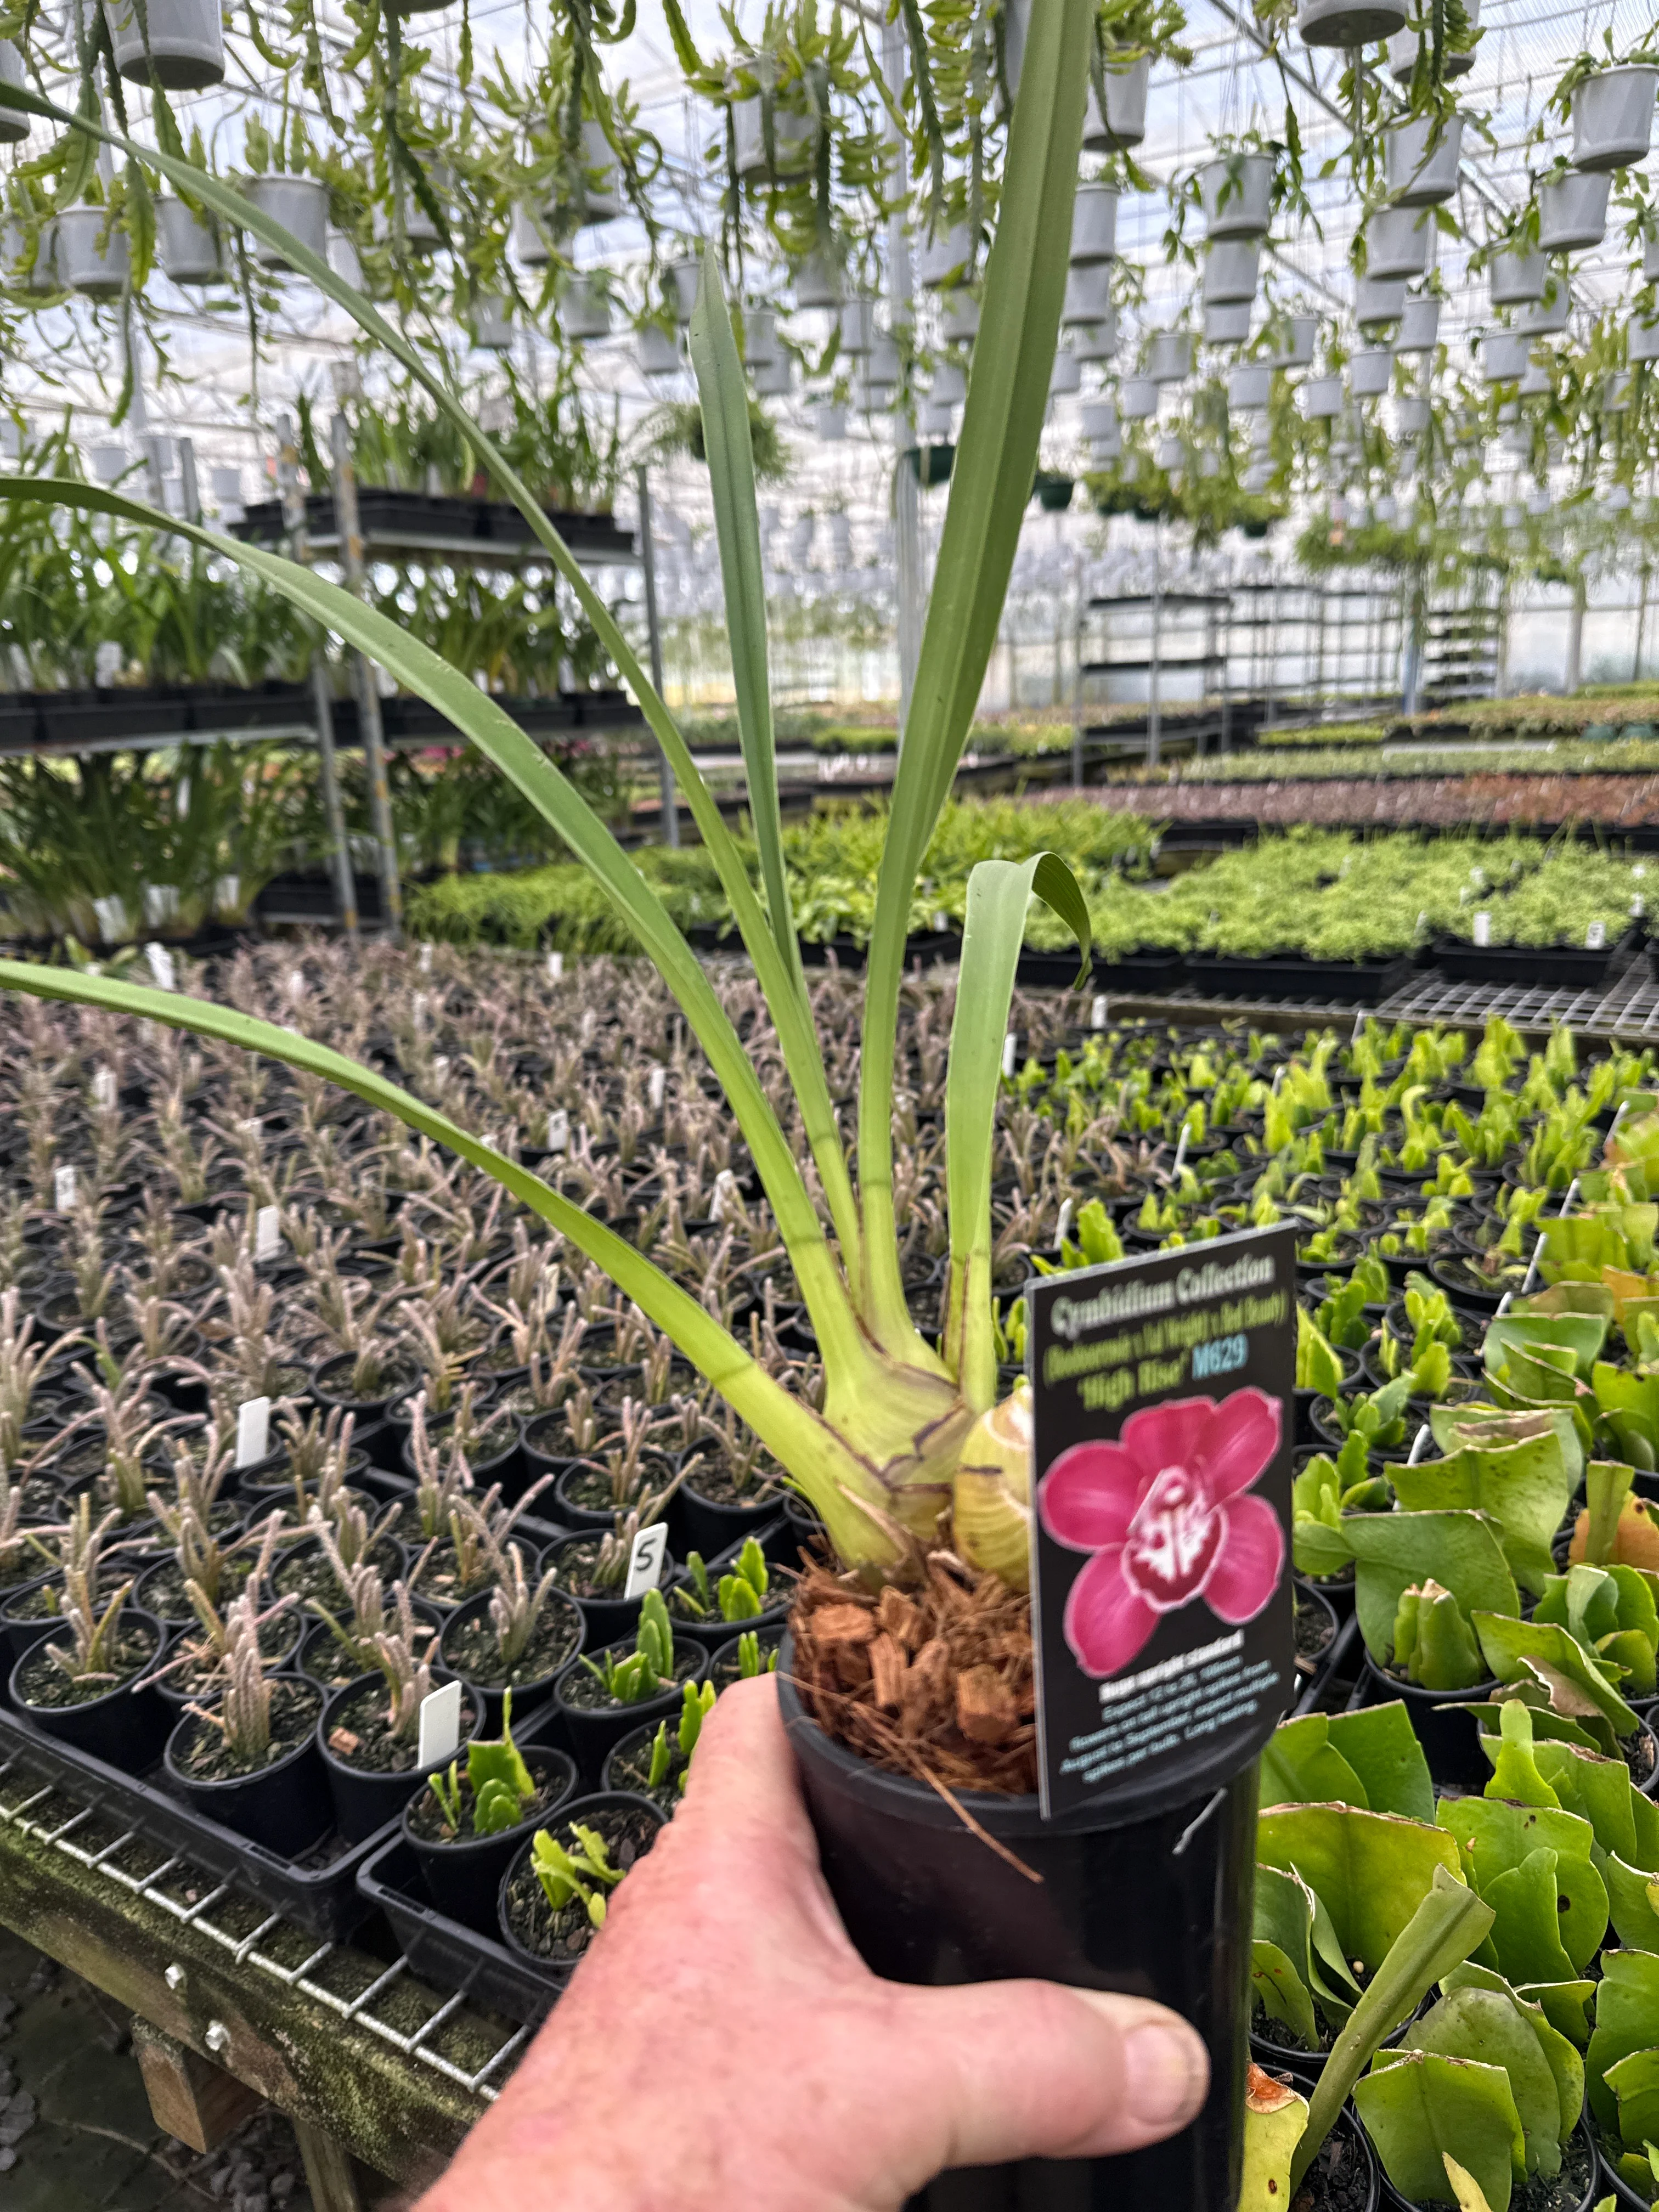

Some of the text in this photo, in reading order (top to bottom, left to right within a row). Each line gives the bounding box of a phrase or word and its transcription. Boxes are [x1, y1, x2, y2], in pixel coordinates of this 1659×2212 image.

[1051, 1252, 1276, 1341] Cymbidium Collection
[1192, 1334, 1249, 1381] M629
[1059, 1744, 1107, 1775] August
[1232, 1671, 1281, 1701] multiple
[1184, 1717, 1217, 1741] Long
